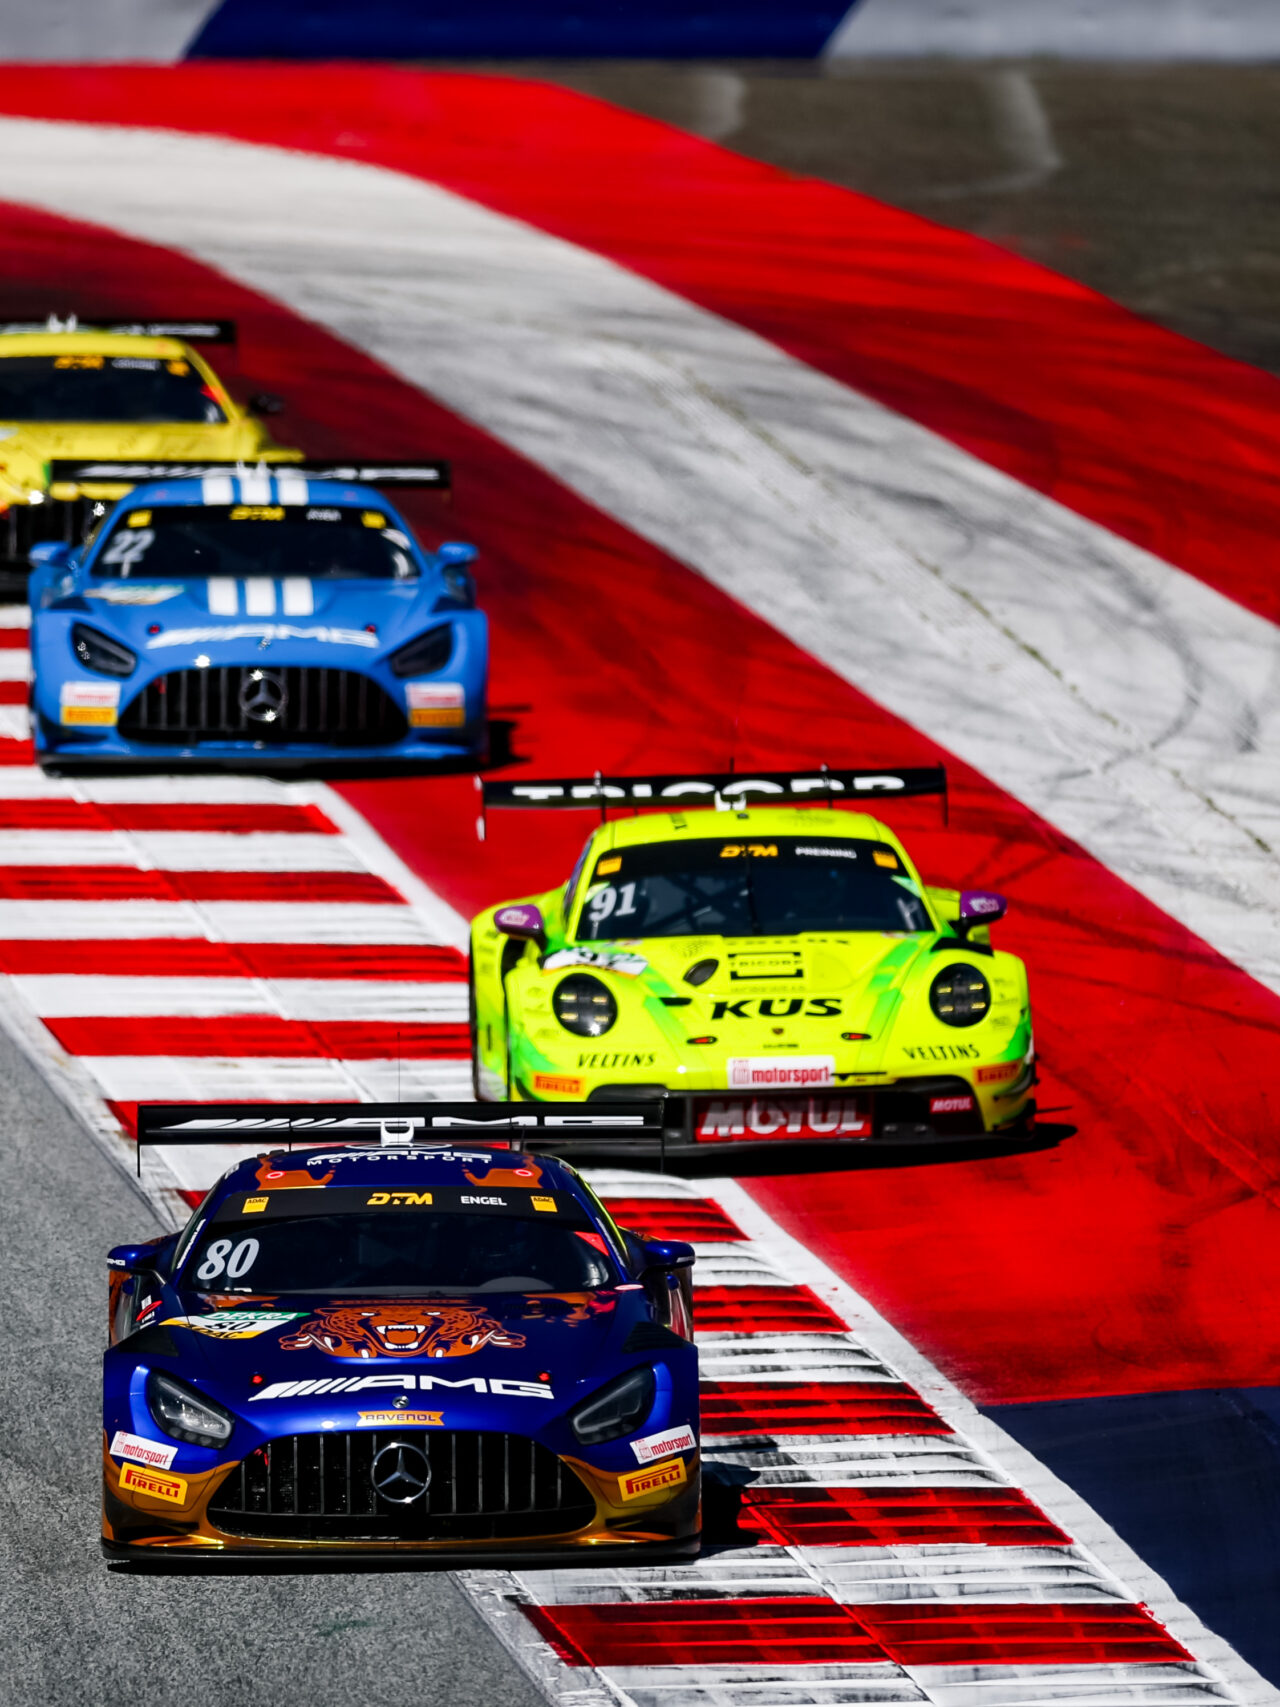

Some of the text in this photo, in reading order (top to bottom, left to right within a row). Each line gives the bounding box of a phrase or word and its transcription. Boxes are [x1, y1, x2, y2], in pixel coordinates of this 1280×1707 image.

[719, 843, 779, 858] DTM
[588, 881, 637, 922] 91
[577, 1052, 656, 1069] VELTINS
[902, 1043, 981, 1061] VELTINS
[751, 1065, 830, 1086] motorsport
[931, 1097, 972, 1112] MOTUL
[700, 1097, 865, 1135] MOTUL
[306, 1154, 493, 1167] MOTORSPORT
[366, 1192, 433, 1205] DTM
[460, 1195, 508, 1206] ENGEL
[196, 1237, 260, 1280] 80
[205, 1311, 299, 1321] DEKRA
[343, 1374, 555, 1400] AMG
[365, 1412, 436, 1422] RAVENOL
[122, 1443, 169, 1465] motorsport
[650, 1433, 694, 1456] motorsport
[124, 1469, 181, 1498] PIRELLI
[625, 1464, 681, 1495] PIRELLI
